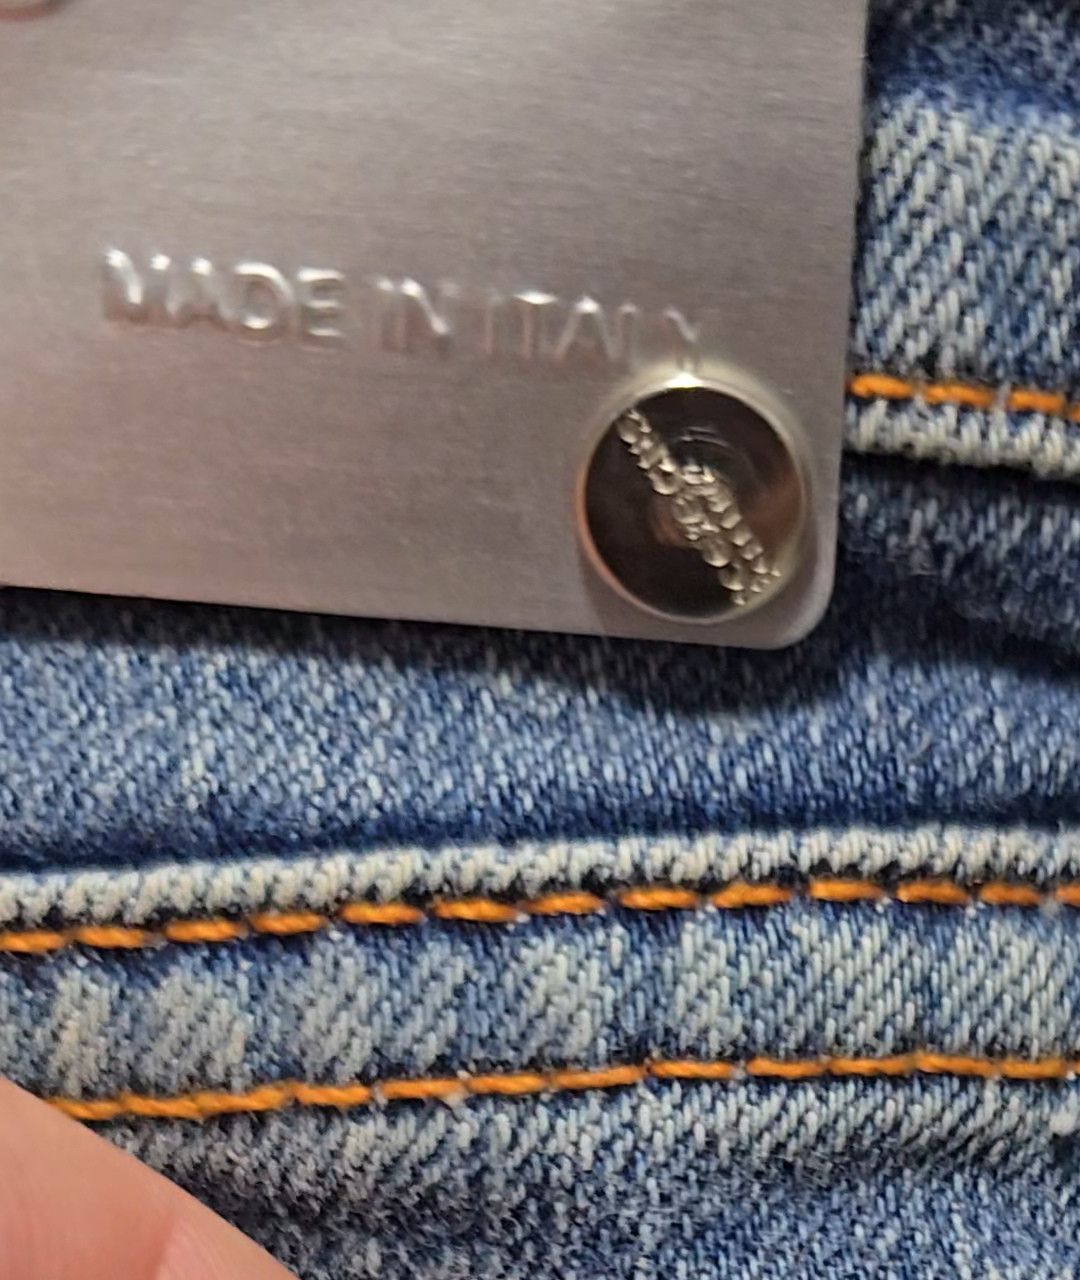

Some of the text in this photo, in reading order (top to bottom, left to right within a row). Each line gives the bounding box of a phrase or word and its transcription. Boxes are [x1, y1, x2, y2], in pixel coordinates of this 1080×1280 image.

[102, 246, 706, 371] MADE IN ITALY
